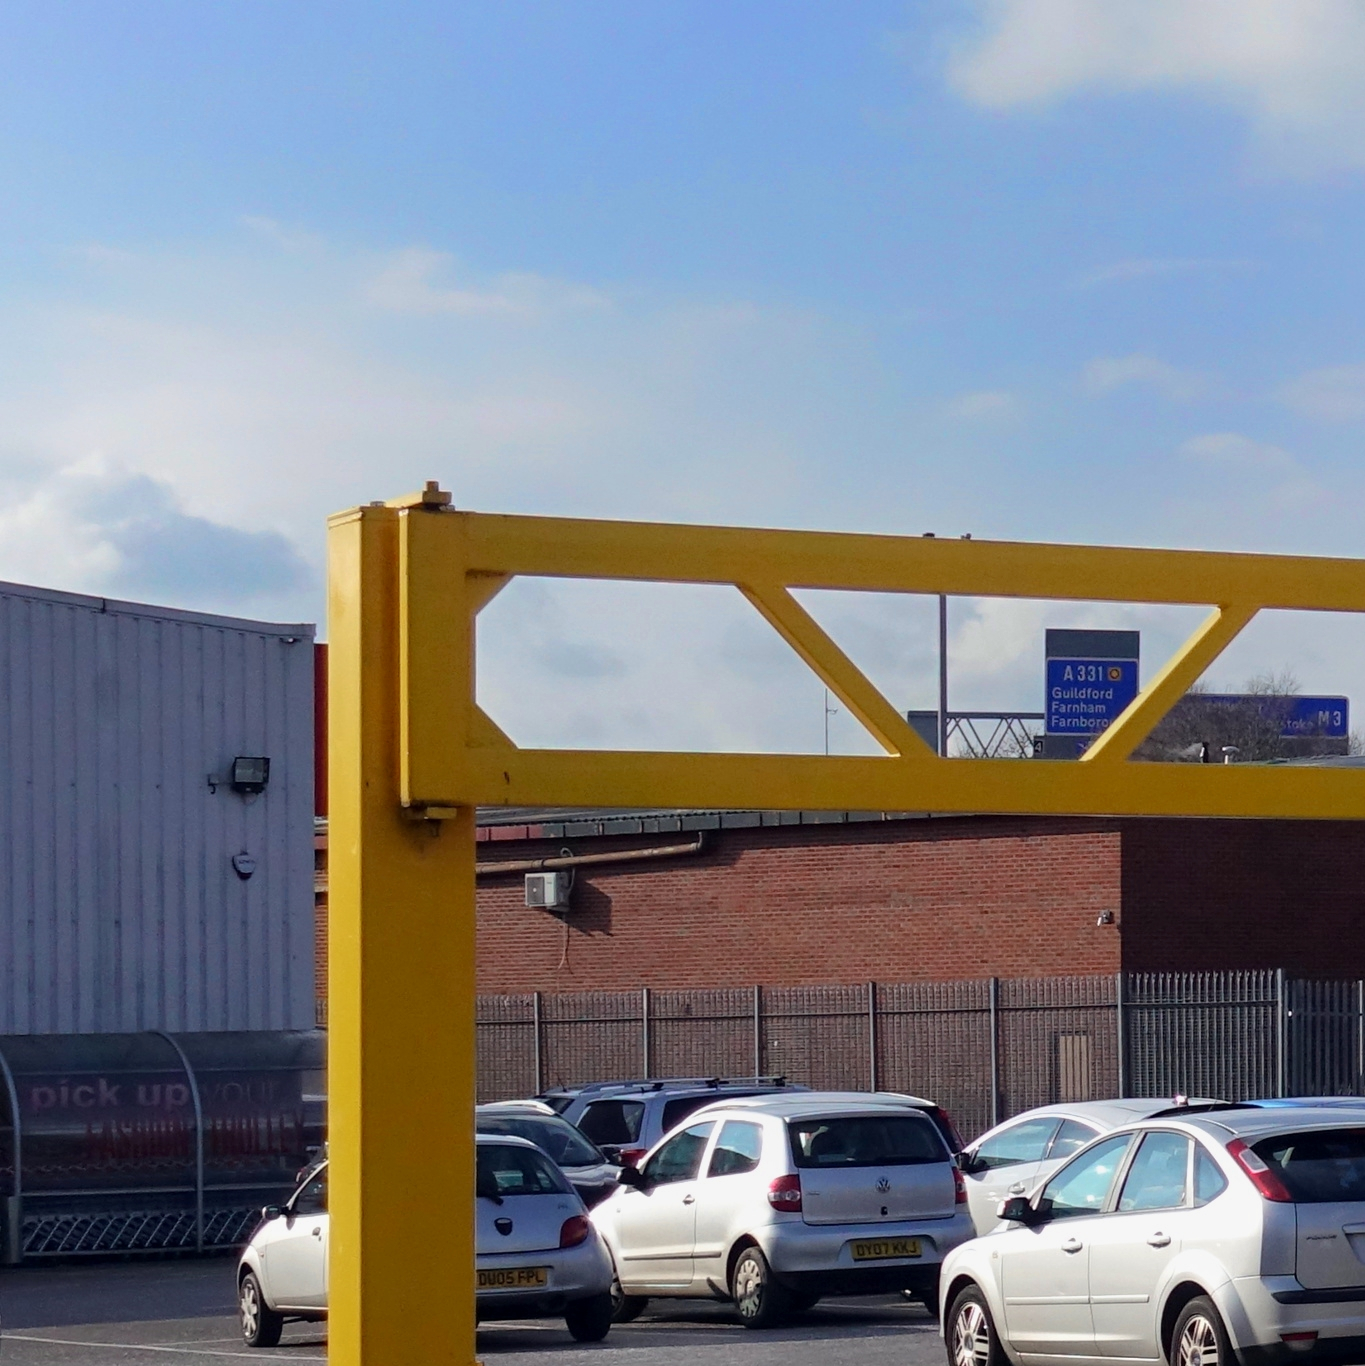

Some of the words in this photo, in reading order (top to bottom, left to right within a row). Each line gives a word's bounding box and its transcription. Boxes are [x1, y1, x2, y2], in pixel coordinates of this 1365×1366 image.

[1052, 687, 1114, 700] Guildford
[1051, 701, 1106, 713] Farnham
[1051, 715, 1111, 728] Farnboro
[30, 1078, 121, 1111] pick
[138, 1083, 190, 1111] up
[479, 1271, 514, 1286] DU05
[517, 1270, 544, 1285] FPL
